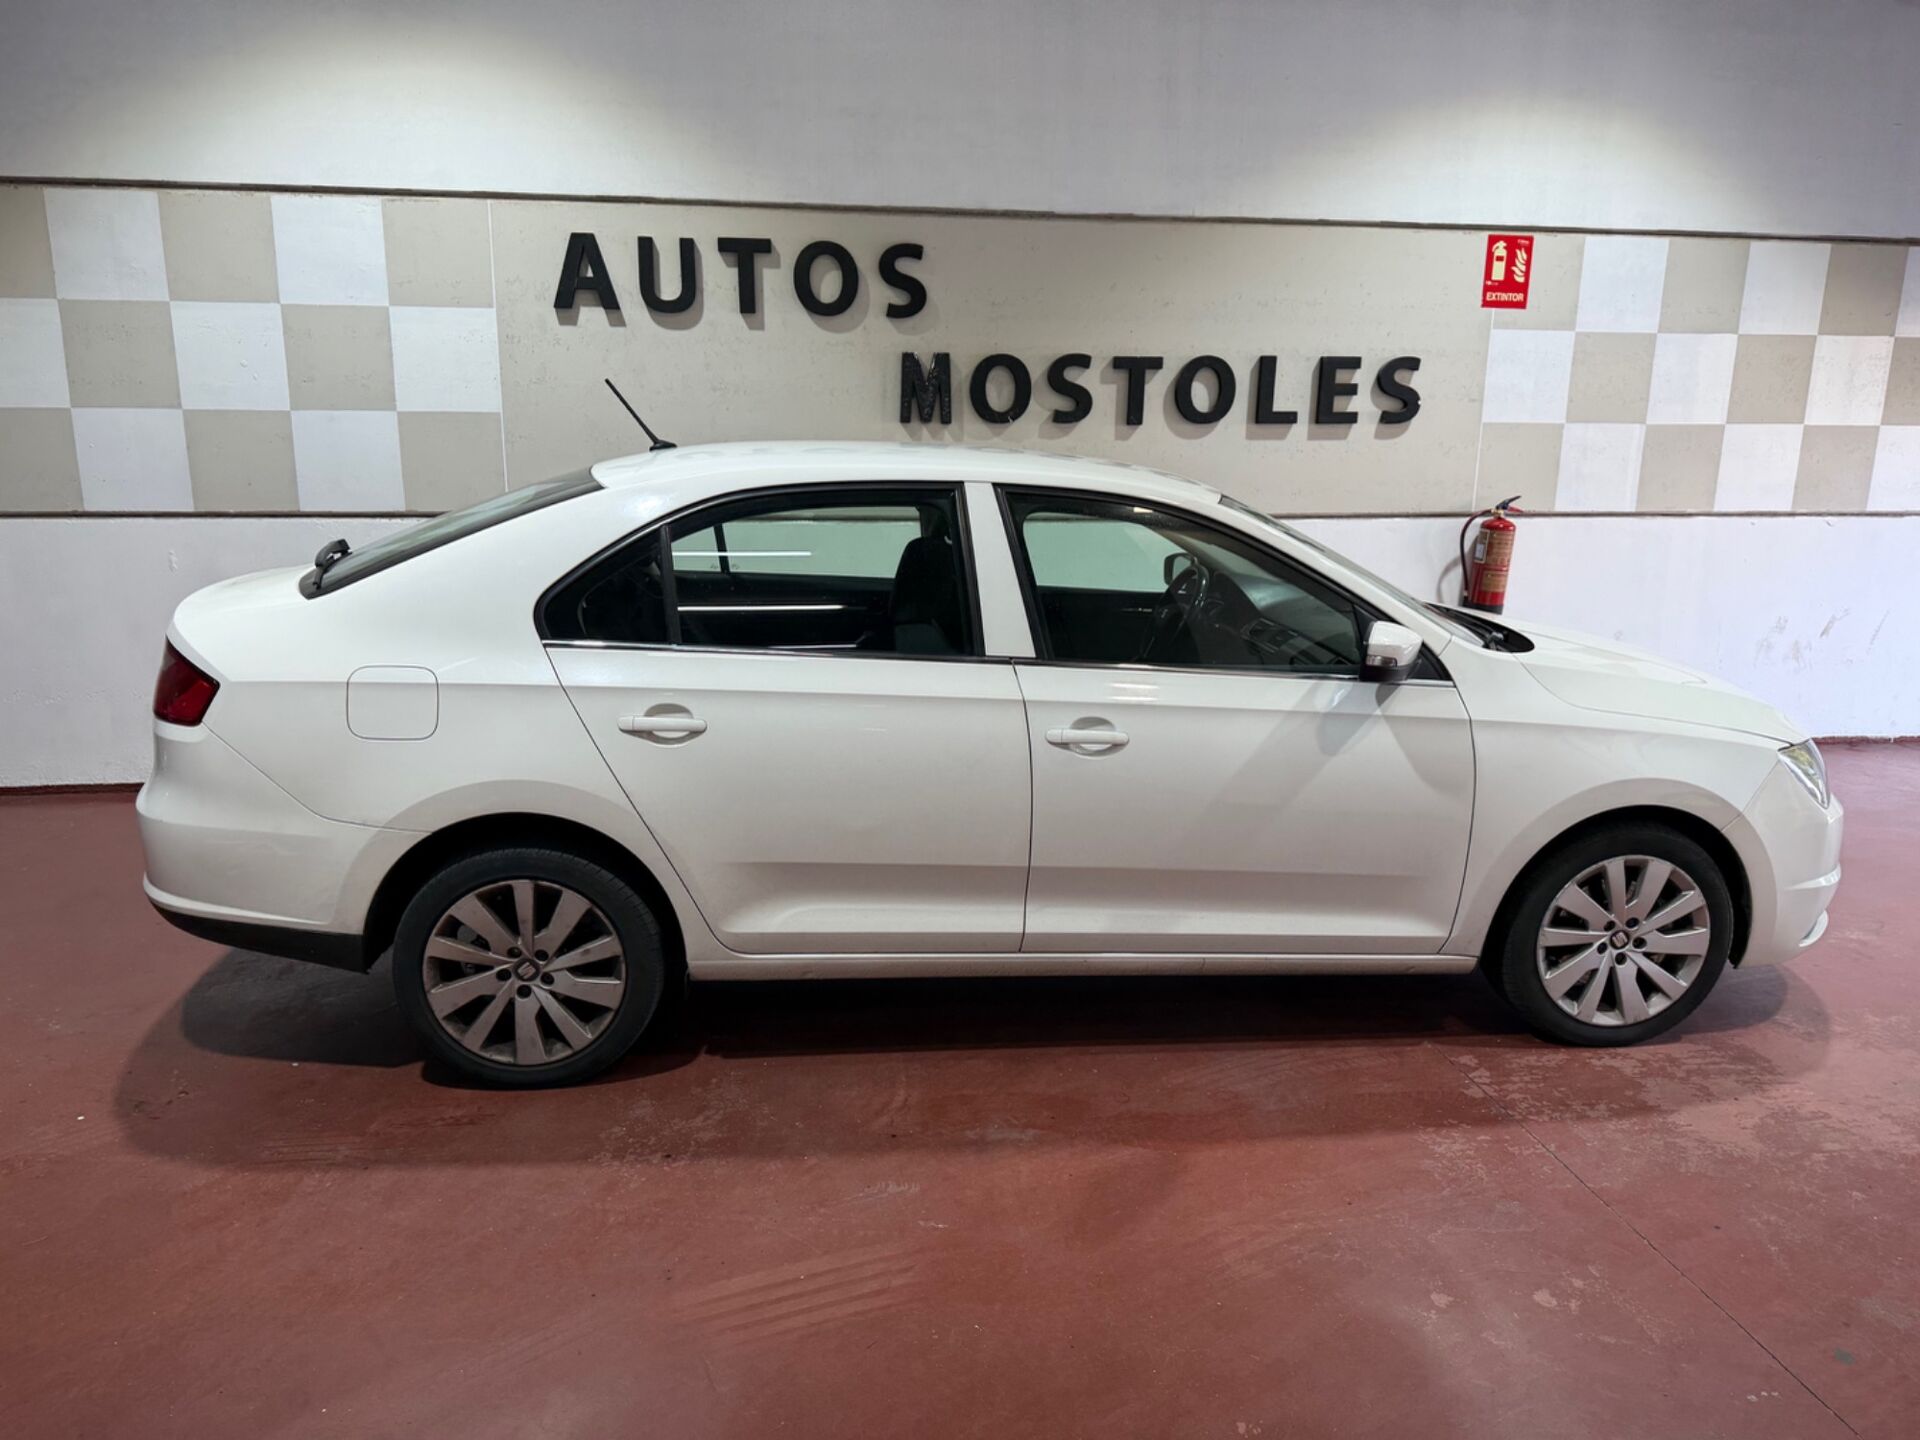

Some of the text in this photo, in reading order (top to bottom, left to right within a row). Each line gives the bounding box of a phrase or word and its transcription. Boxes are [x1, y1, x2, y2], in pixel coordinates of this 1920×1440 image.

[554, 233, 927, 318] AUTOS
[1486, 292, 1524, 302] EXTINTOR
[900, 352, 1421, 425] MOSTOLES
